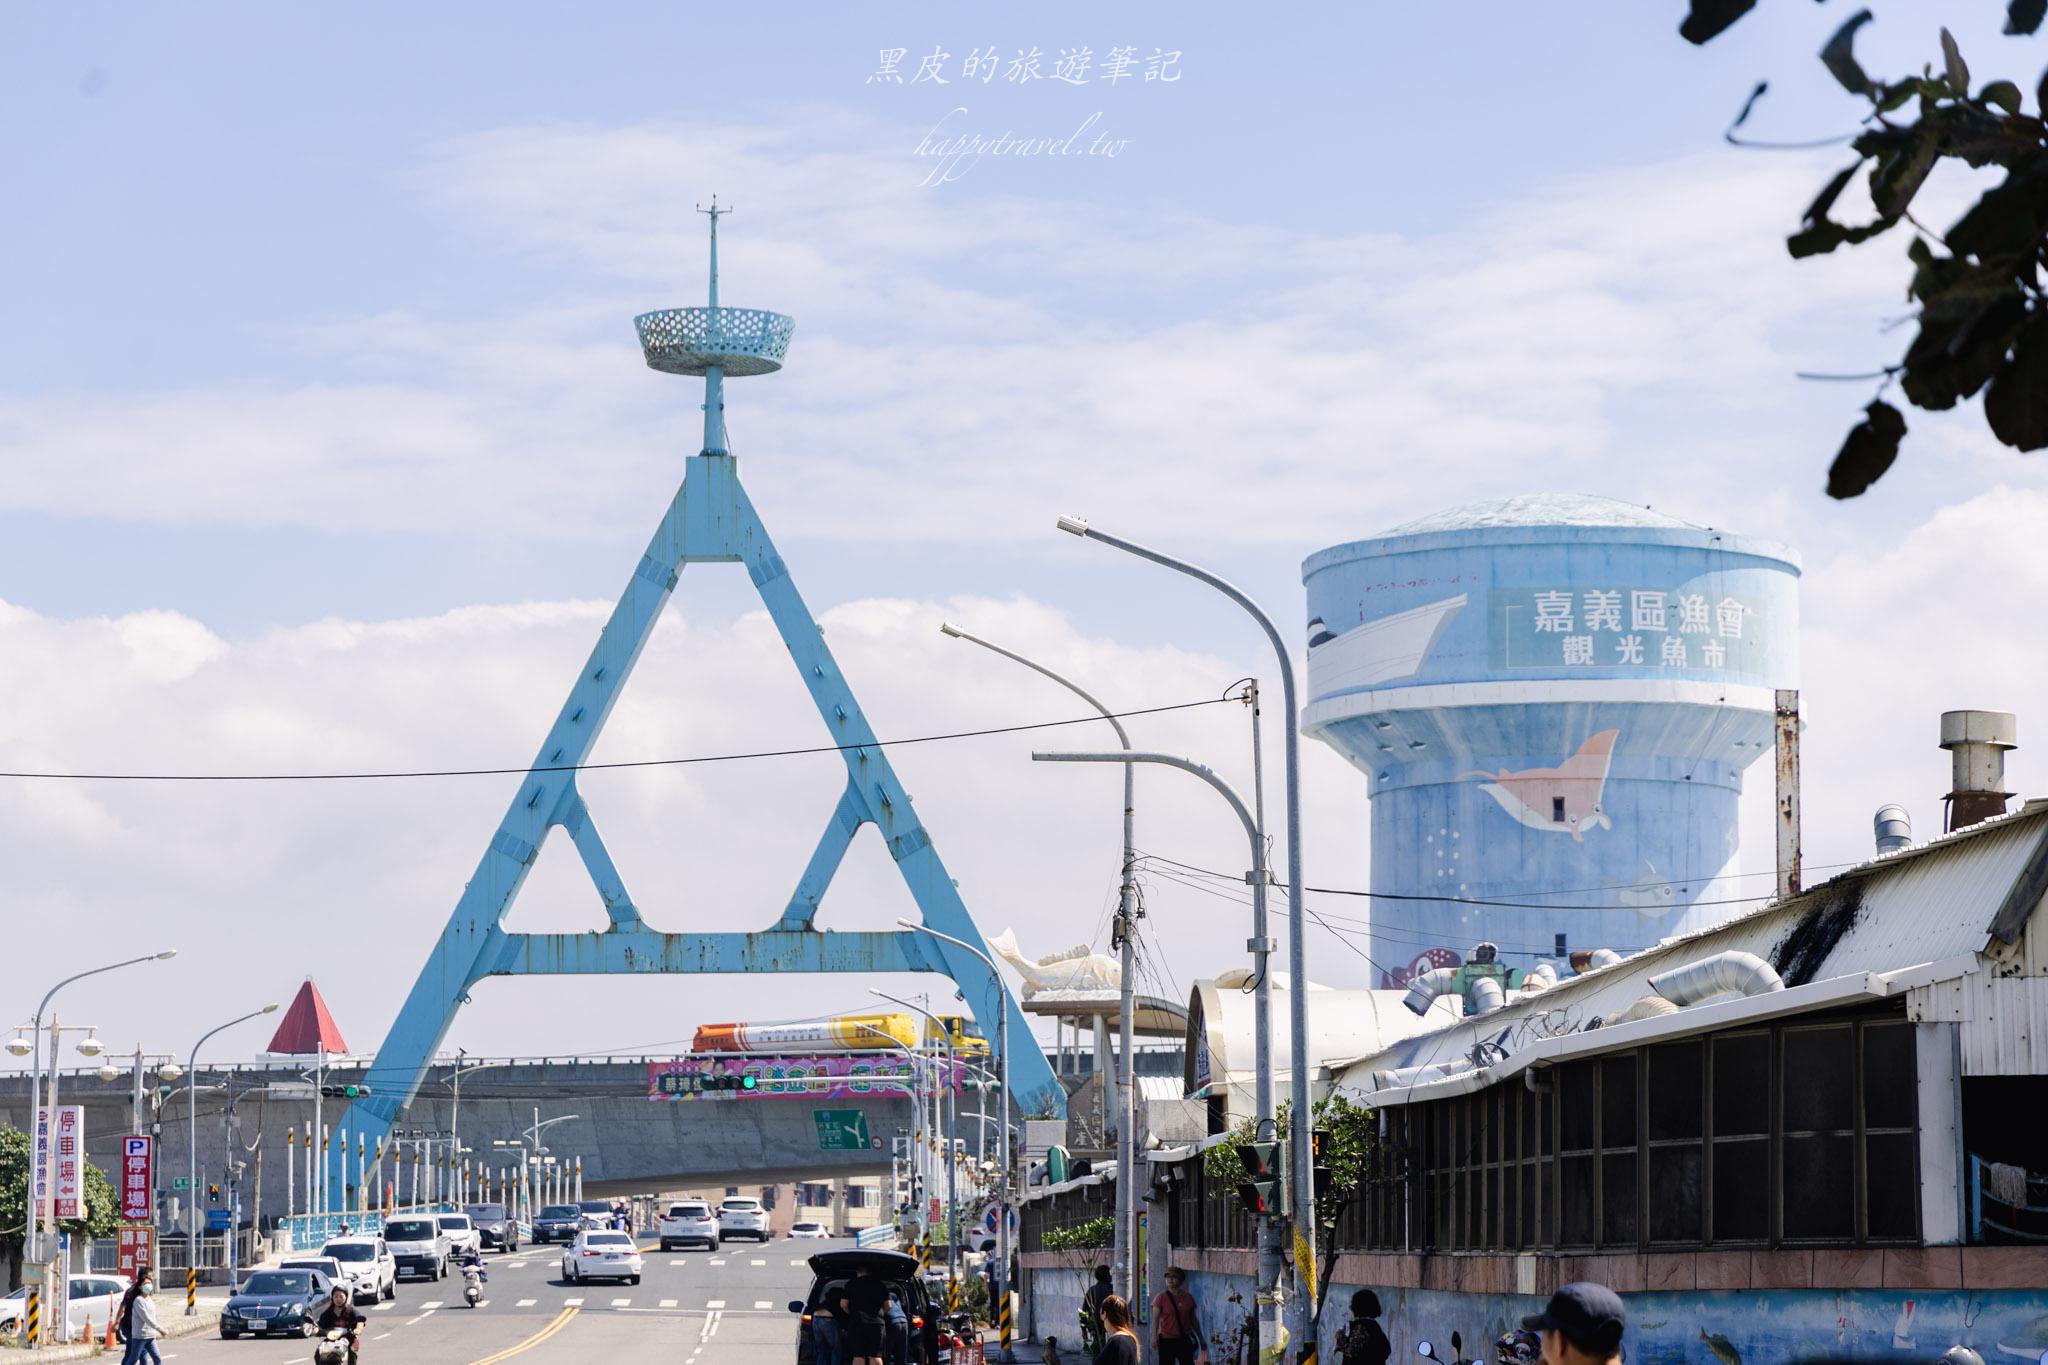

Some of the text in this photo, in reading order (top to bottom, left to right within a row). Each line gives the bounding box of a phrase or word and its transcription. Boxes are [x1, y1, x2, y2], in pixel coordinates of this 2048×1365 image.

[1534, 590, 1745, 639] 嘉義區漁會
[1562, 635, 1727, 668] 觀光魚市
[60, 1110, 75, 1182] 停車場
[129, 1141, 143, 1154] P
[127, 1157, 146, 1206] 停車場
